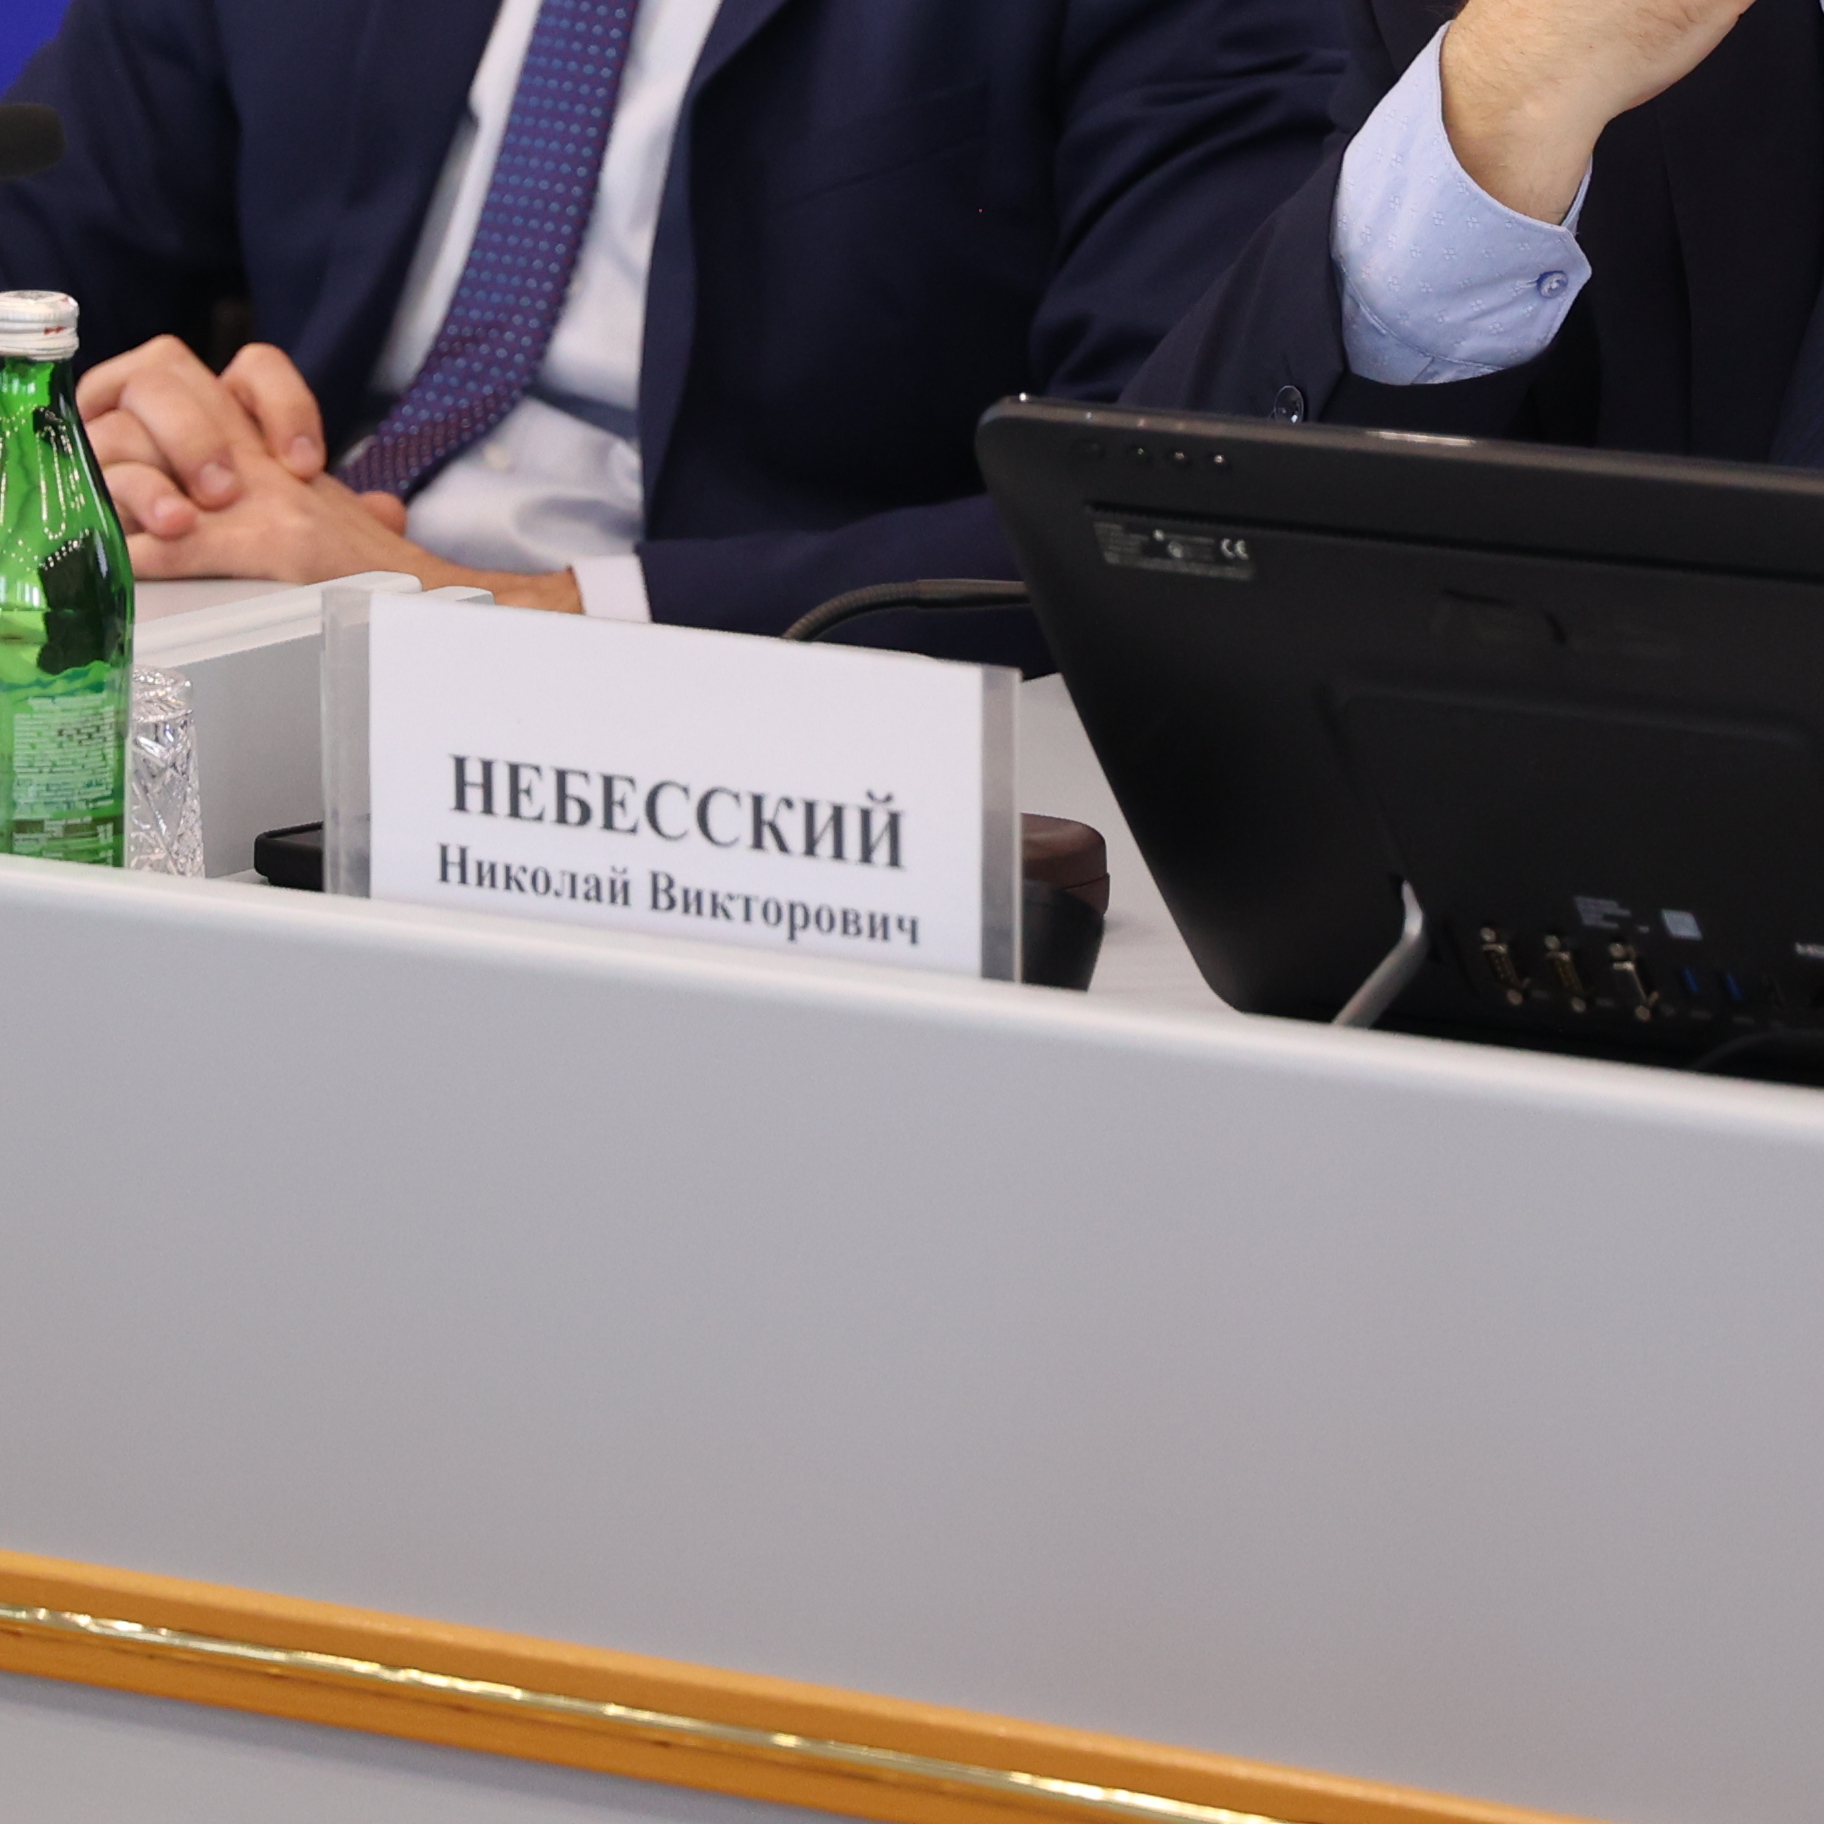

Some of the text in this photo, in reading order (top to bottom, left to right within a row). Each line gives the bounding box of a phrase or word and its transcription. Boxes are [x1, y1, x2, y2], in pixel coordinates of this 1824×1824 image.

[452, 754, 902, 870] НЕБЕССКИЙ
[438, 843, 919, 946] Николай Викторович
